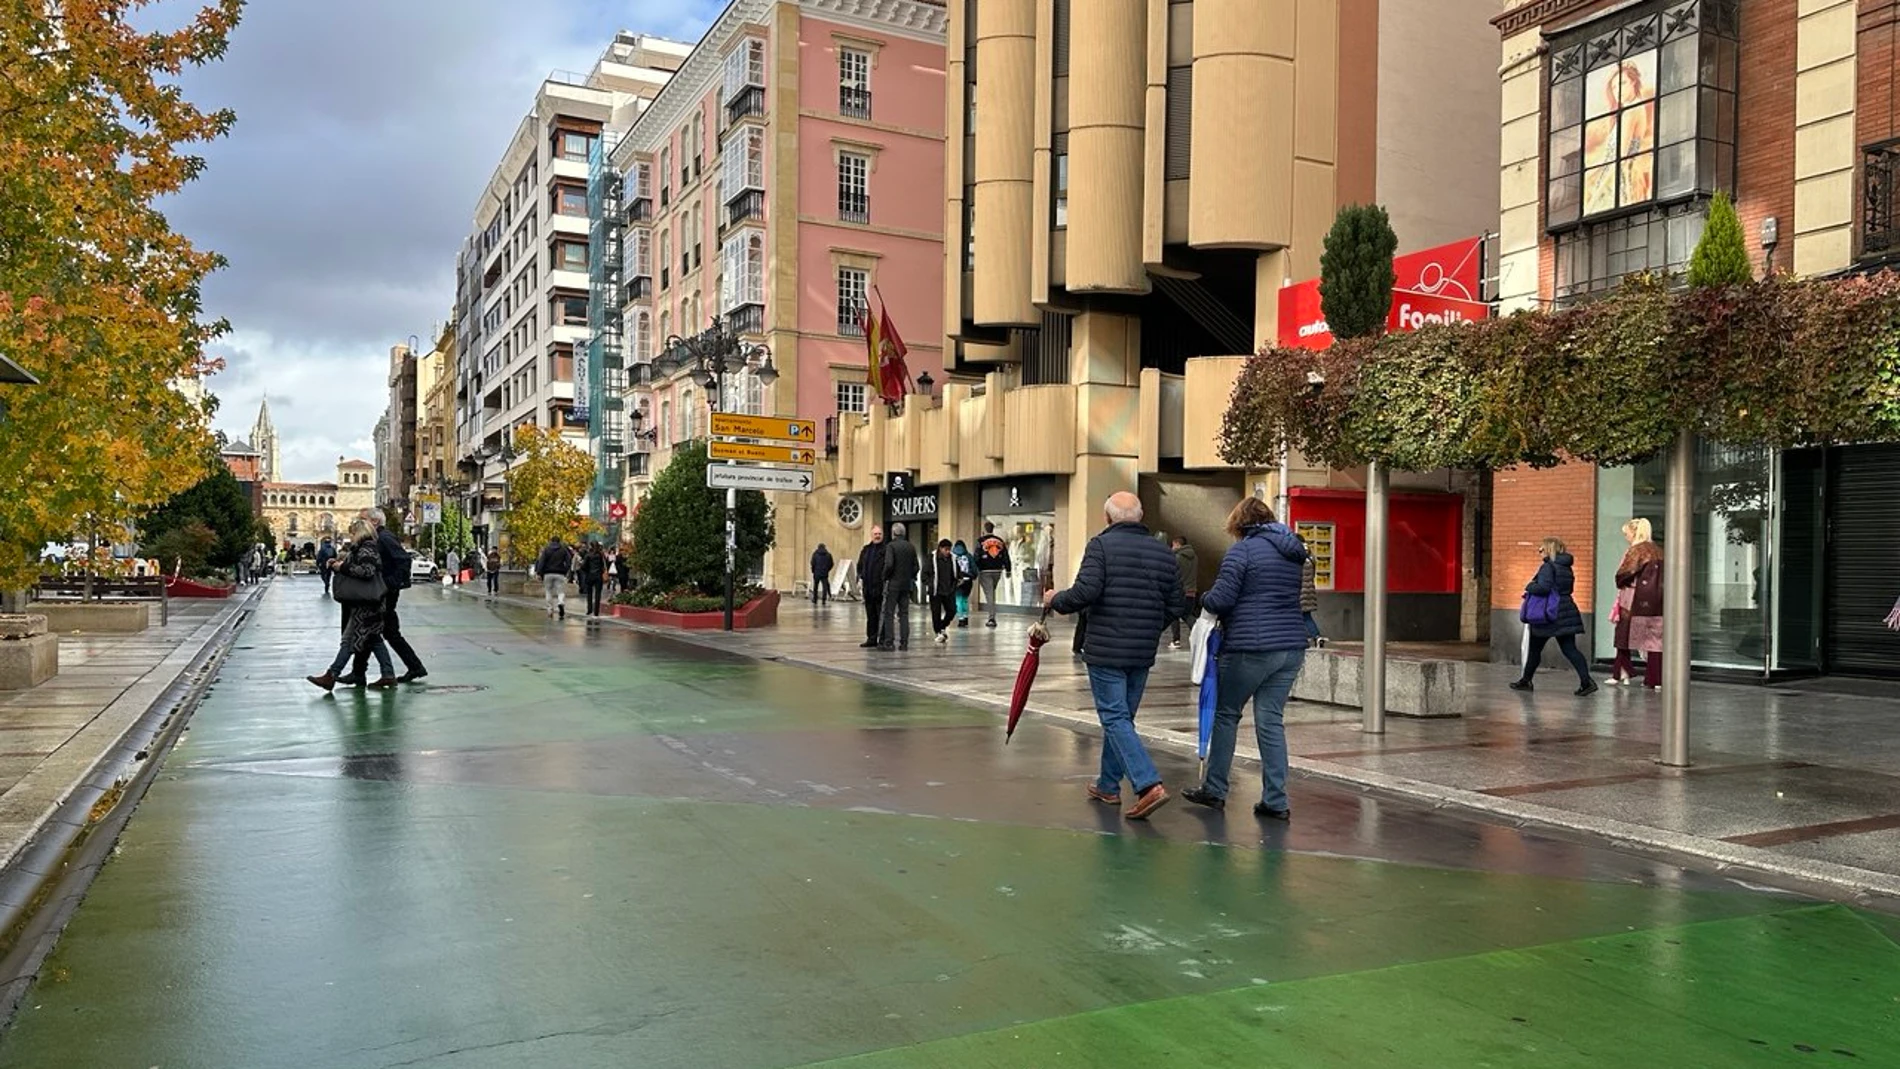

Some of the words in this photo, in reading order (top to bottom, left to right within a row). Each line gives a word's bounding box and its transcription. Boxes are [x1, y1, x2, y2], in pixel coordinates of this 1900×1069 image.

[1299, 319, 1329, 337] auto
[734, 425, 764, 435] Marcelo
[738, 474, 764, 482] provincial
[892, 495, 936, 516] SCALPERS
